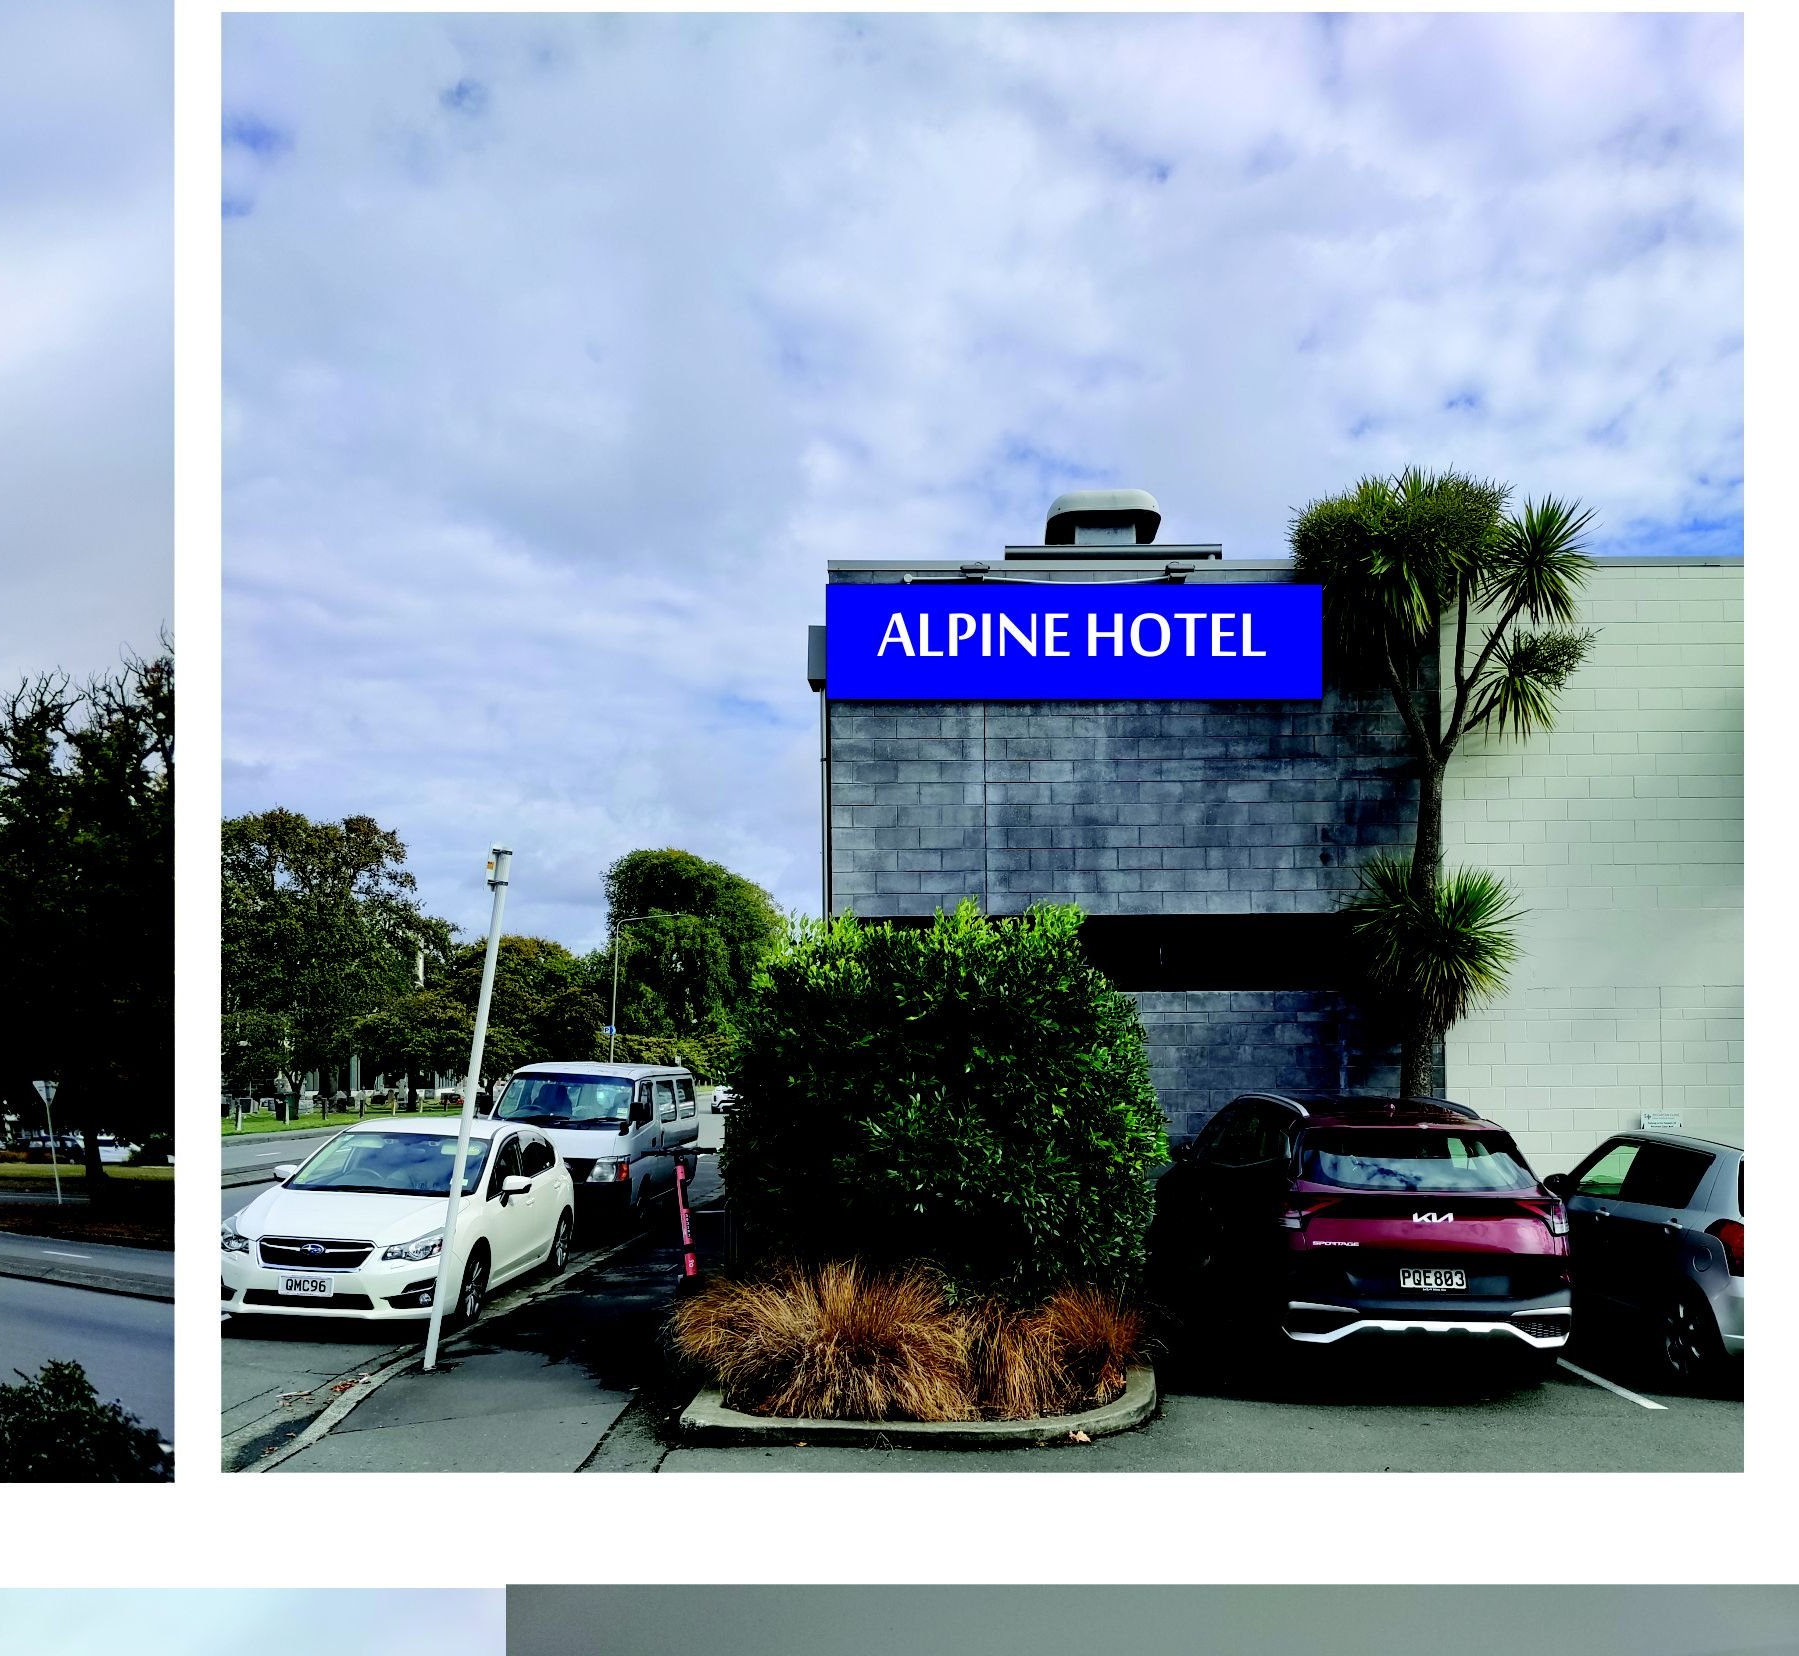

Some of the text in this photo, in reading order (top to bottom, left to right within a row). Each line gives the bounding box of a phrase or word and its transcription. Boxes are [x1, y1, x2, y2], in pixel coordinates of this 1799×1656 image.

[877, 612, 1267, 657] ALPINE HOTEL
[1412, 1202, 1454, 1223] KIA
[286, 1279, 327, 1293] QMC96
[1402, 1270, 1465, 1287] PQE803
